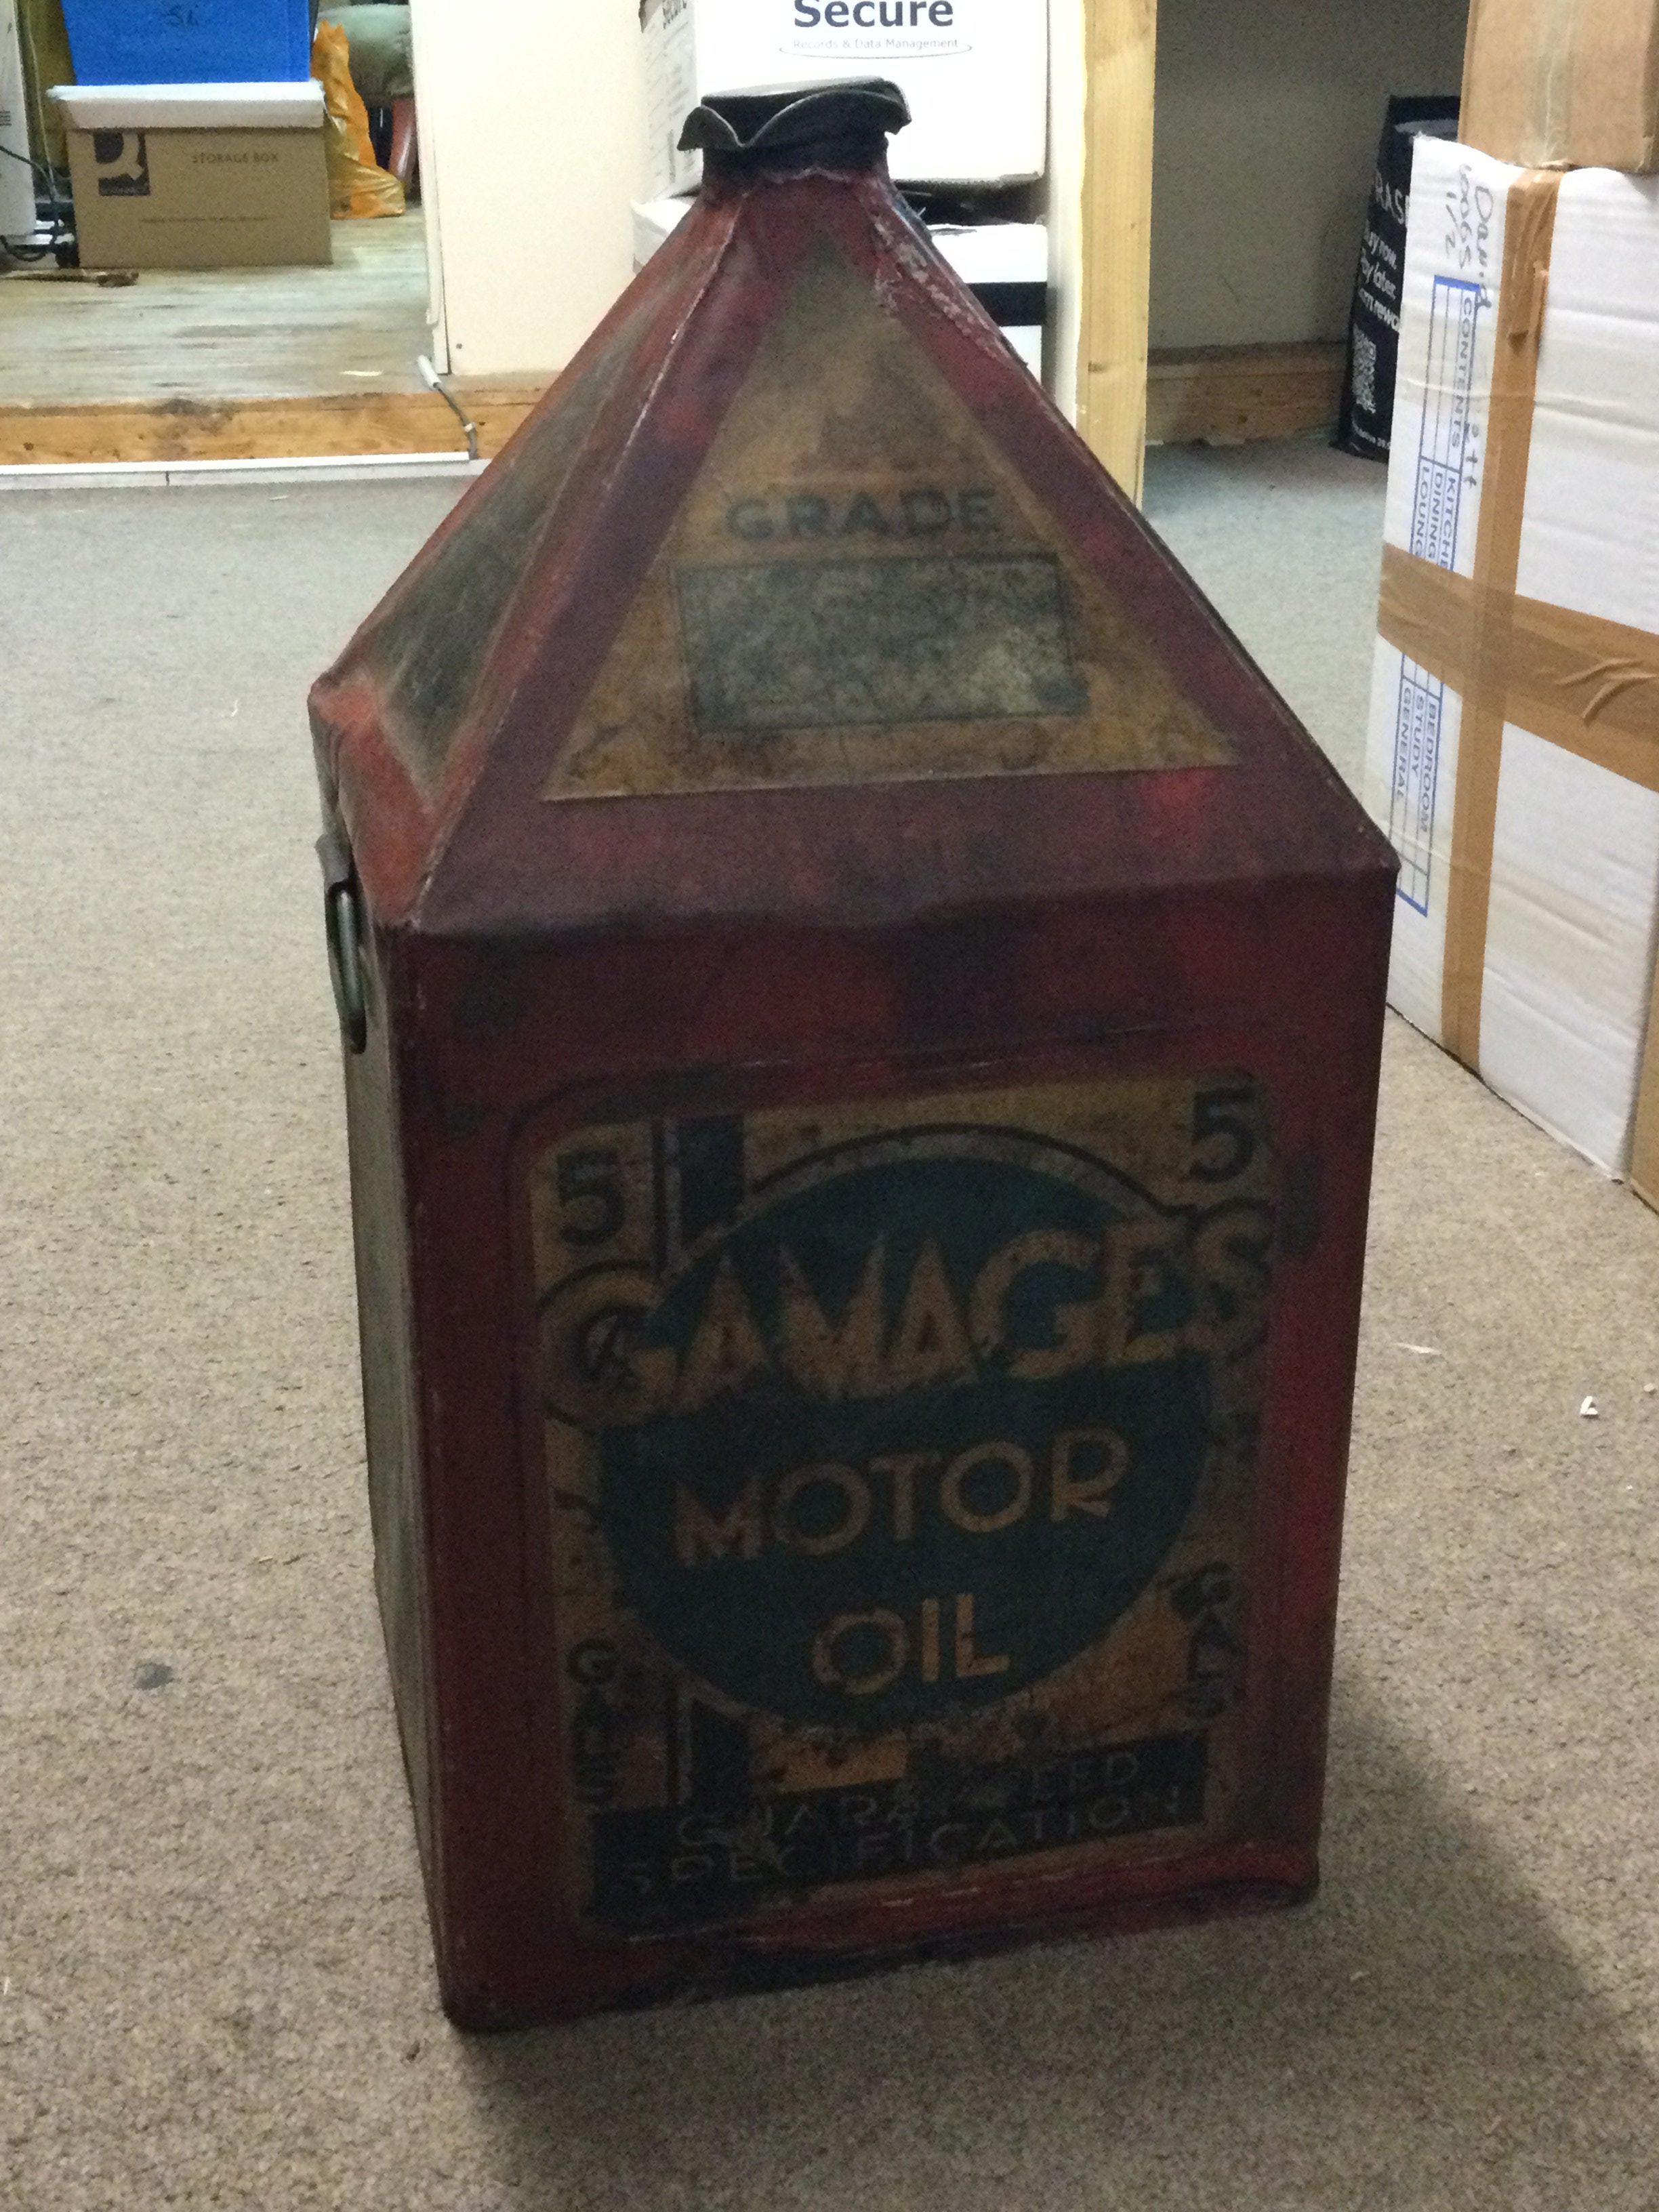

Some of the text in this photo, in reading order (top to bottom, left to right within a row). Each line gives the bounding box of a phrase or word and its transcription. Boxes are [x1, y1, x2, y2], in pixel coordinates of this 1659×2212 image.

[793, 38, 958, 51] Records & Data Management
[794, 0, 954, 28] Secure
[192, 152, 279, 164] STORAGE BOX
[1452, 297, 1473, 448] CONTENTS
[725, 485, 999, 542] GRADE
[1428, 472, 1443, 558] DINING
[1396, 687, 1412, 800] GENERAL
[1411, 694, 1425, 779] STUDY
[1420, 702, 1438, 833] BEDROOM
[1189, 1087, 1254, 1183] 5
[557, 1151, 625, 1246] 5
[540, 1199, 1274, 1425] GAMAGES
[670, 1427, 1132, 1565] MOTOR
[813, 1591, 1010, 1696] OIL
[622, 1782, 1183, 1896] SPECIFICATION
